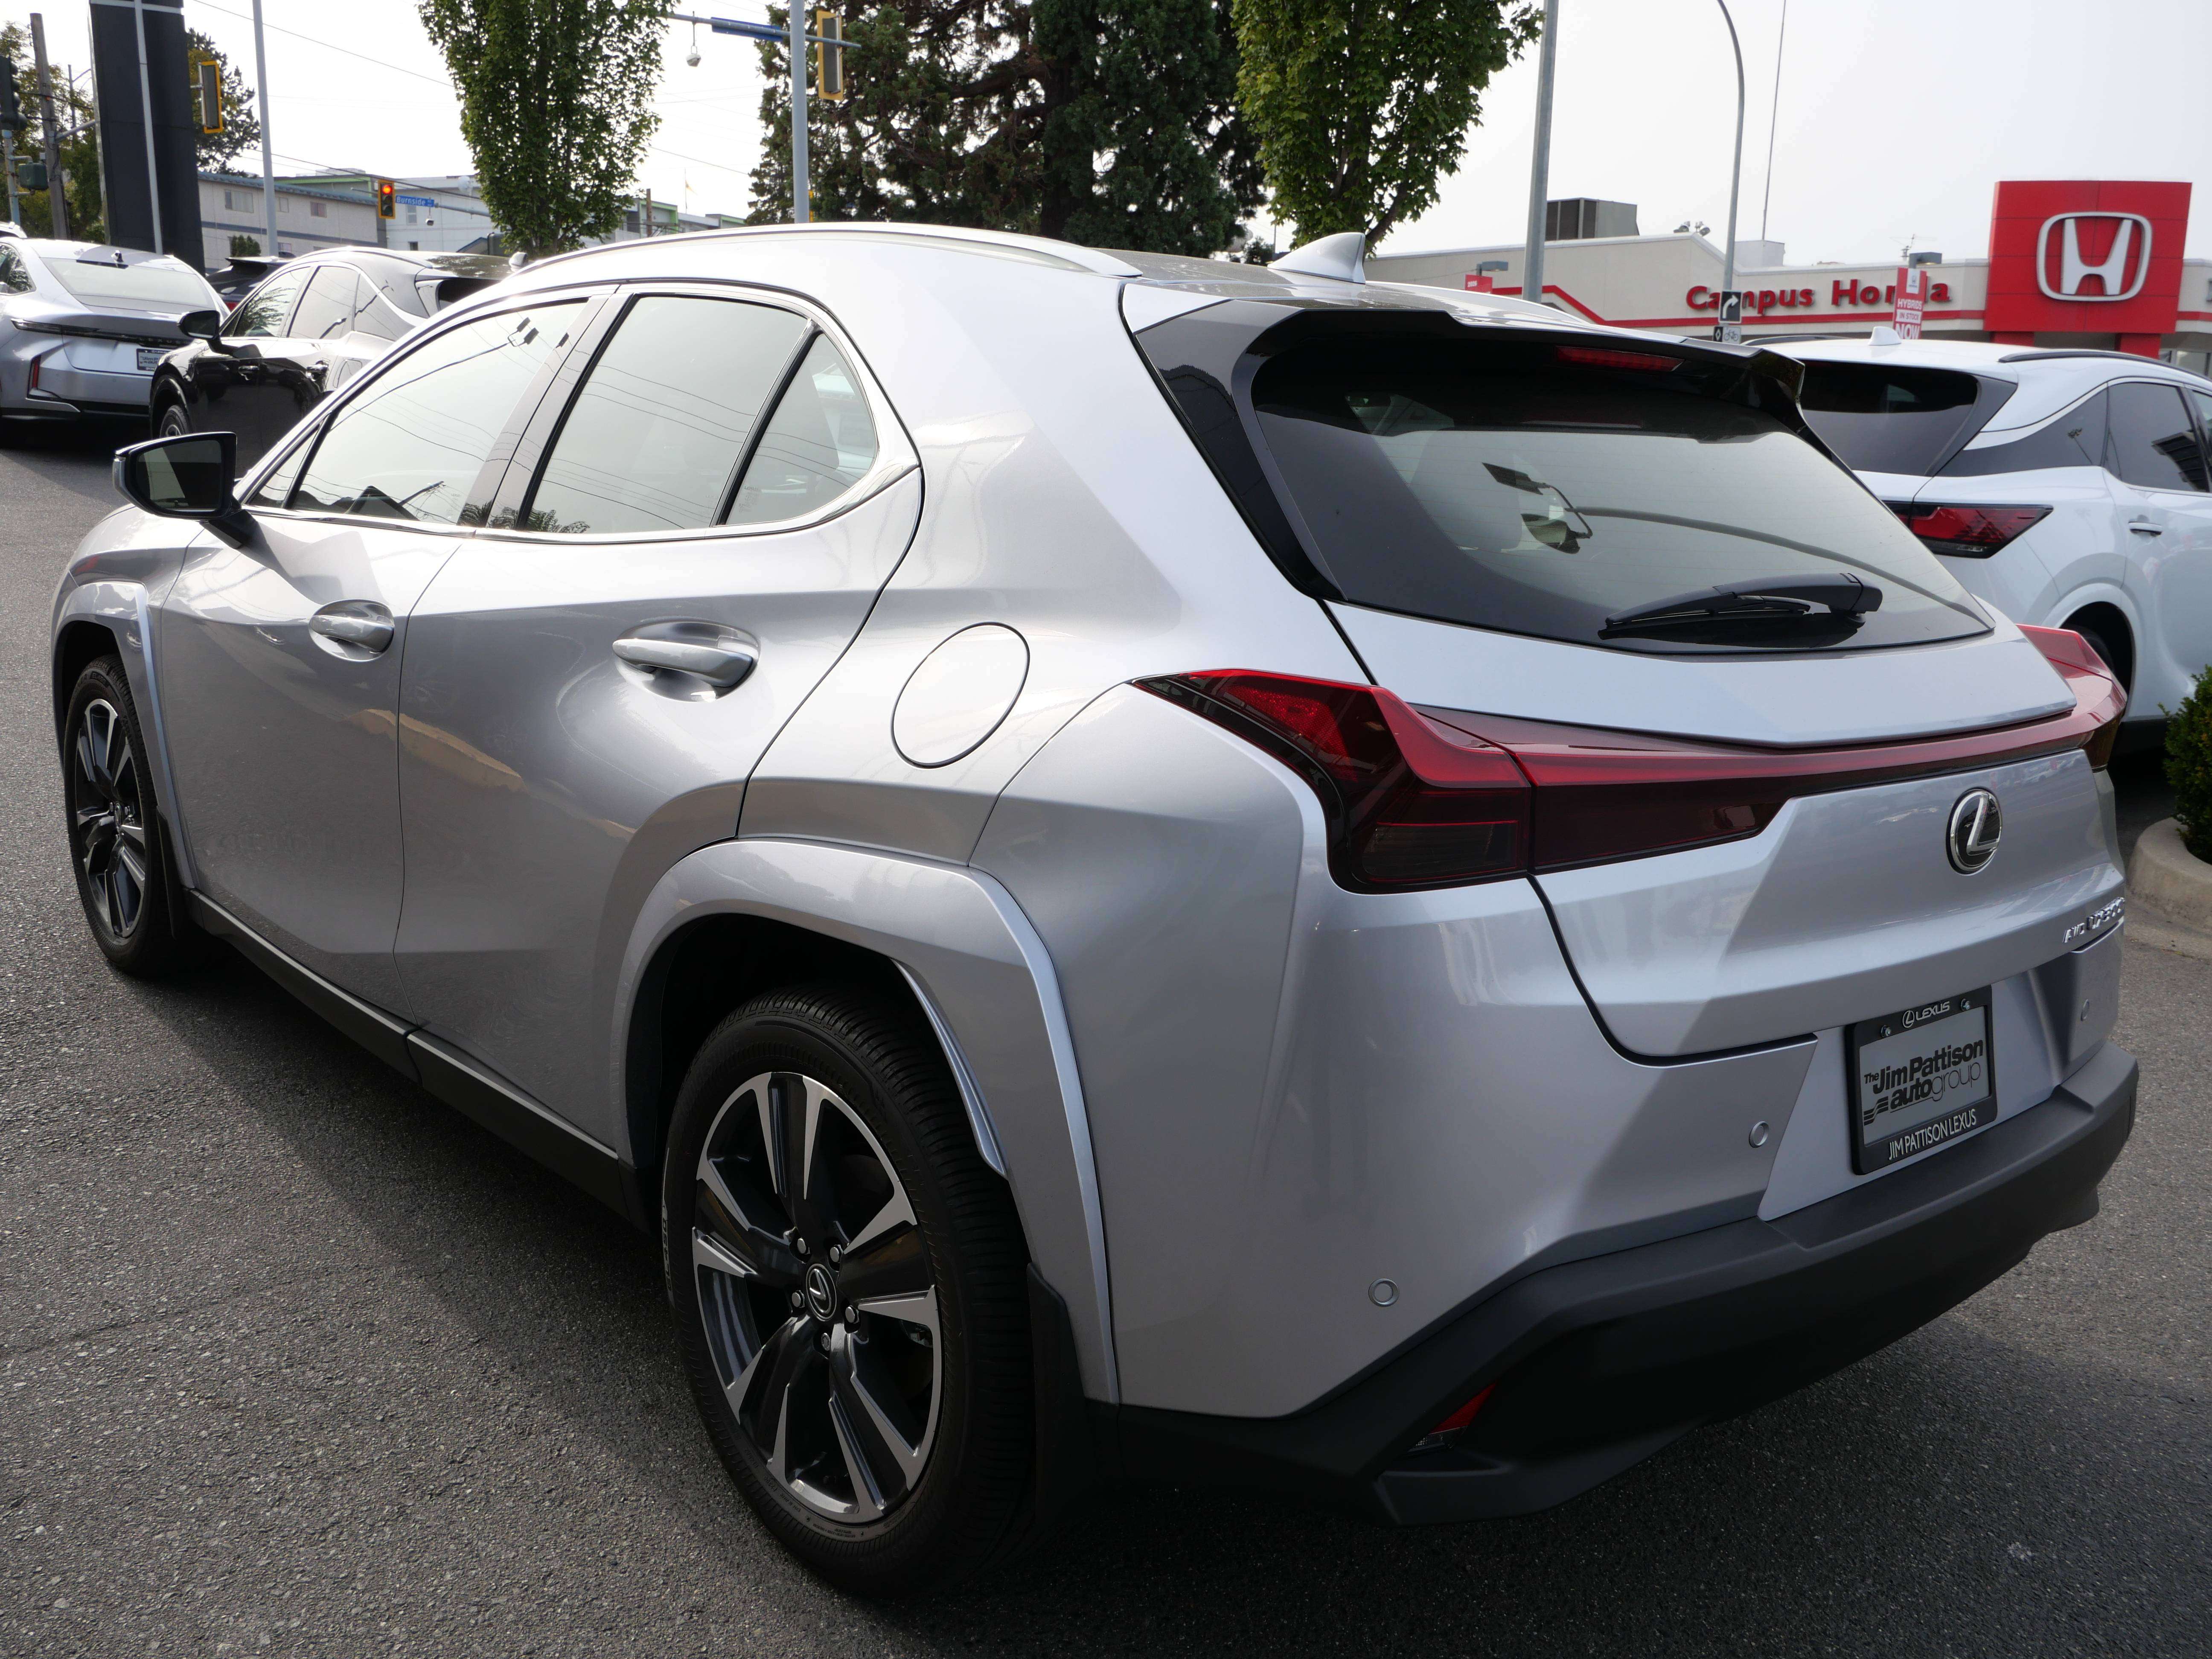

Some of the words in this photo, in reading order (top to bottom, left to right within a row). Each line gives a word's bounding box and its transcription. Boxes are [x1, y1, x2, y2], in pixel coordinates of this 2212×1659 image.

[397, 196, 425, 205] Burnside
[1831, 276, 1950, 306] Hona
[1898, 298, 1922, 310] HYBRIDS
[1896, 323, 1920, 340] NOW
[1915, 1001, 1950, 1020] LEXUS
[1864, 1072, 1879, 1084] The
[1889, 1138, 1903, 1160] JIM
[1905, 1120, 1948, 1153] PATTISON
[1948, 1109, 1976, 1135] LEXUS
